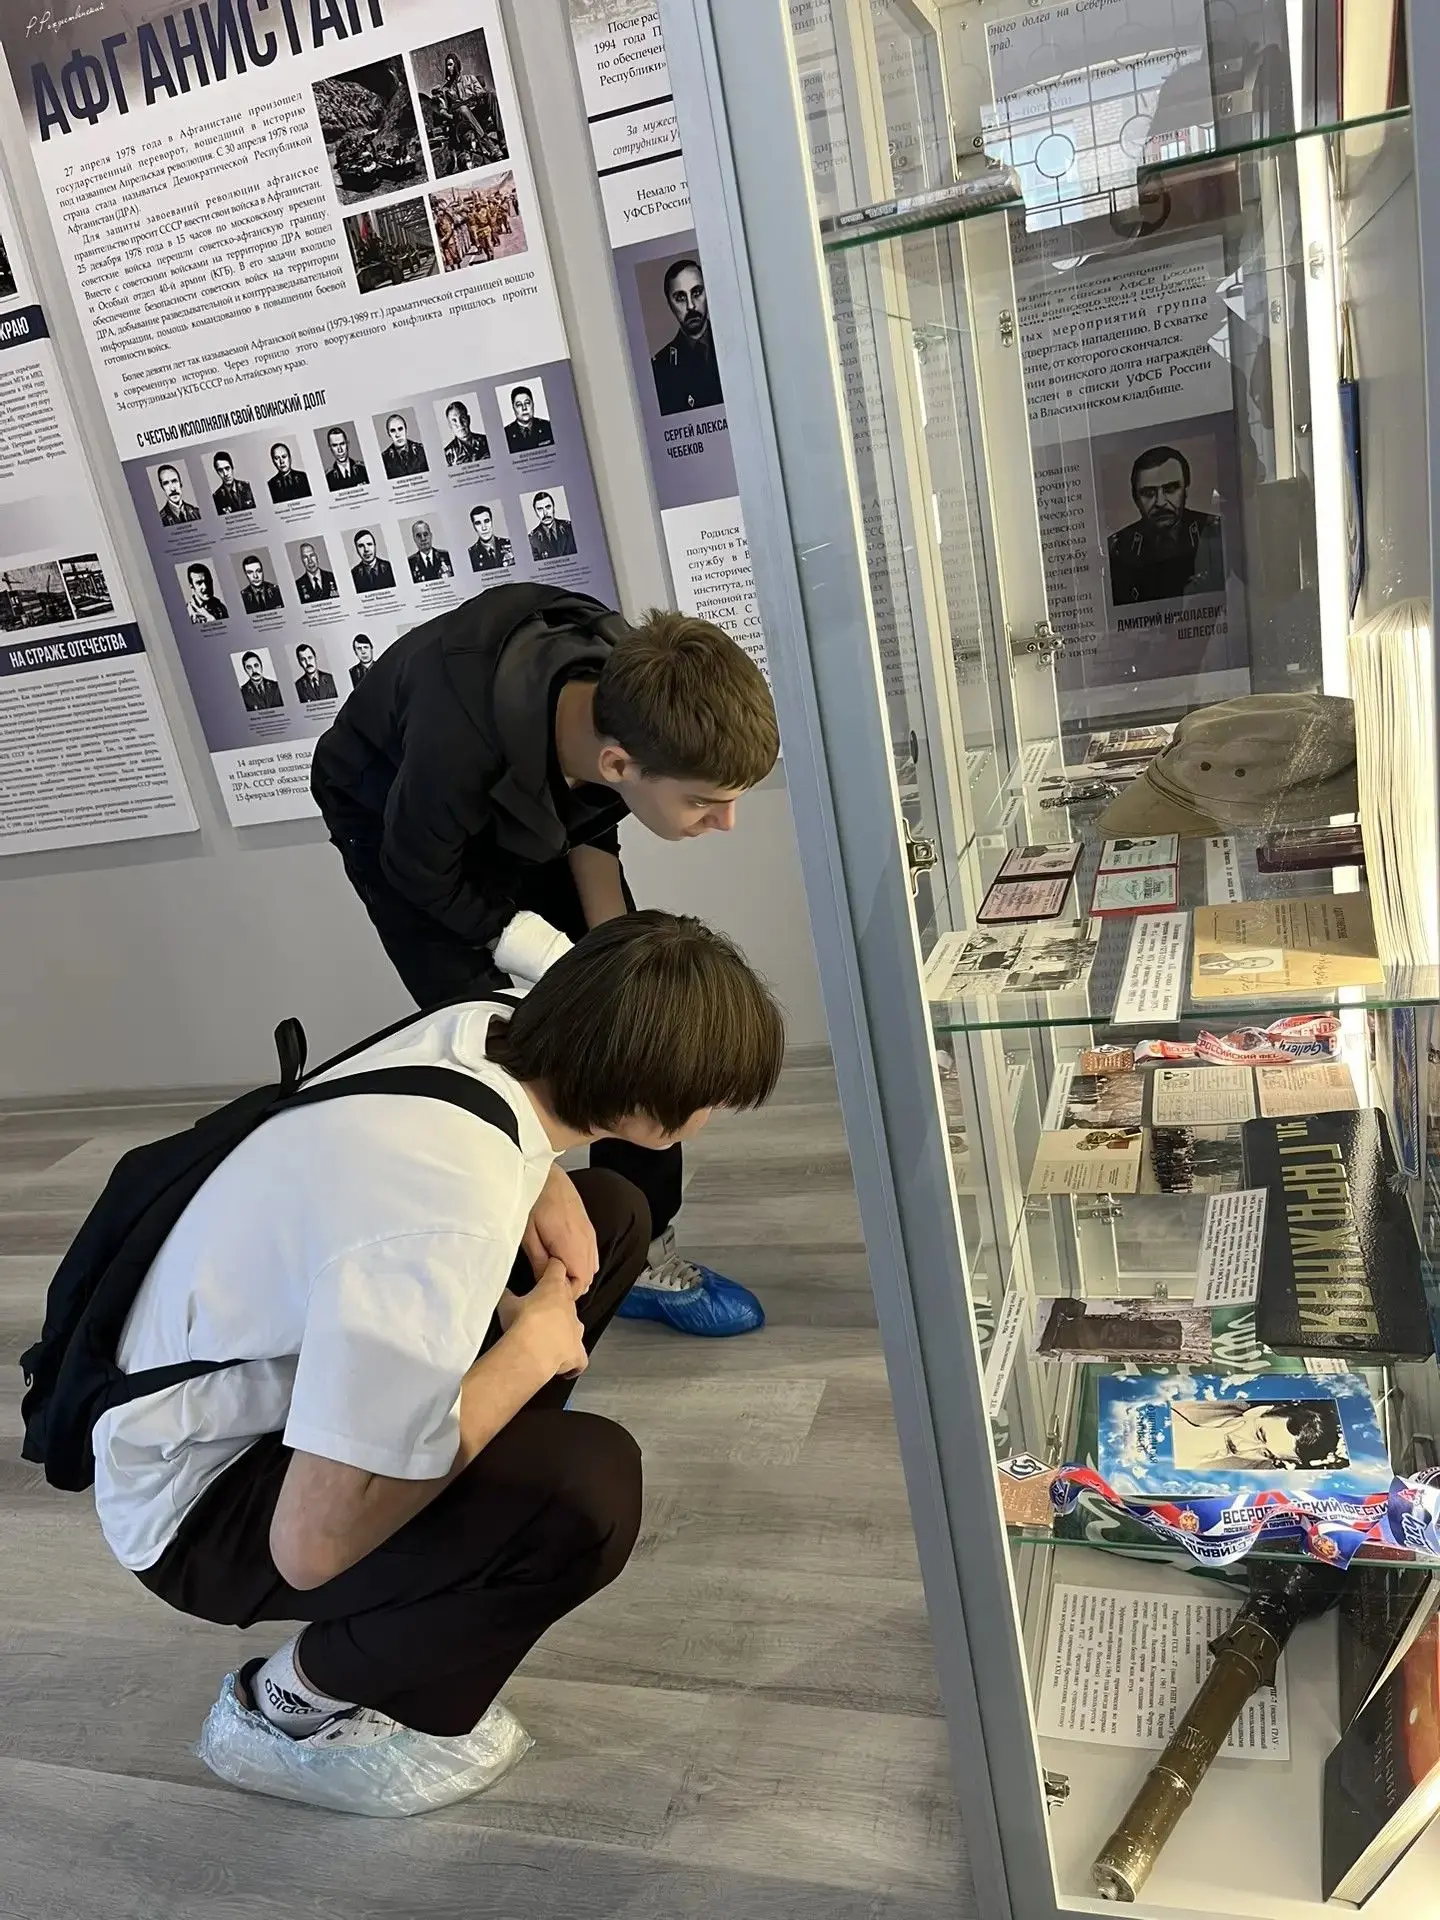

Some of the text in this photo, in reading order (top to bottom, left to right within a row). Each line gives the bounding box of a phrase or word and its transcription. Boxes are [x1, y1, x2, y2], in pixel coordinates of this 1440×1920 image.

[607, 17, 639, 33] После
[1022, 13, 1051, 28] долга
[1056, 8, 1070, 18] на
[593, 38, 616, 54] 1994
[622, 32, 645, 46] года
[597, 60, 610, 70] по
[599, 62, 666, 86] Республики»
[63, 165, 73, 177] 27
[80, 156, 110, 172] апреля
[116, 145, 136, 159] 1978
[141, 139, 162, 151] года
[179, 112, 241, 139] Афганистане
[248, 92, 302, 117] произошел
[626, 124, 637, 136] За
[55, 162, 132, 194] государственный
[137, 146, 188, 167] переворот,
[193, 125, 244, 148] вошедший
[262, 107, 305, 126] историю
[612, 133, 668, 156] сотрудники
[59, 121, 308, 207] под названием Апрельская революция. С 30 апреля 1978 года
[62, 135, 312, 221] страна стала называться Демократической Республикой
[636, 184, 676, 200] Немало
[82, 165, 318, 244] Для защиты завоеваний революции афганское
[623, 202, 654, 222] УФСБ
[67, 203, 141, 234] Афганистан (ДРА).
[84, 223, 332, 300] Вместе с советскими войсками на территорию ДРА вошел
[1052, 308, 1146, 336] мероприятий
[1157, 295, 1206, 315] группа
[0, 316, 30, 342] КРАЮ
[123, 376, 176, 396] современную
[181, 366, 219, 381] историю.
[223, 358, 249, 371] Через
[254, 348, 289, 364] горнило
[295, 341, 318, 353] этого
[323, 324, 386, 345] вооруженного
[392, 310, 442, 328] конфликта
[448, 297, 496, 316] пришлось
[502, 286, 537, 302] пройти
[1080, 325, 1152, 347] нападению.
[1153, 319, 1161, 331] В
[1162, 312, 1208, 328] схватке
[1052, 358, 1065, 368] от
[1066, 347, 1118, 365] которого
[1119, 334, 1182, 354] скончался.
[1048, 366, 1106, 385] воинского
[1109, 359, 1142, 374] долга
[1145, 343, 1210, 365] награждён
[1066, 389, 1072, 397] в
[1078, 379, 1119, 394] списки
[1126, 367, 1162, 387] УФСБ
[1168, 360, 1211, 376] России
[1039, 395, 1120, 418] Власихинском
[1122, 383, 1183, 402] кладбище.
[136, 389, 326, 447] С ЧЕСТЬЮ ИСПОЛНЯЛИ СВОЙ ВОИНСКИЙ ДОЛГ
[664, 418, 727, 440] СЕРГЕЙ АЛЕКСА
[667, 442, 703, 457] ЧЕБЕКОВ
[700, 526, 739, 539] Родился
[686, 542, 726, 556] получил
[688, 555, 724, 569] службу
[690, 565, 751, 582] на историчес
[693, 581, 743, 595] института,
[695, 593, 742, 611] районной
[697, 603, 752, 619] ВЛКСМ. С
[1116, 602, 1227, 632] ДМИТРИЙ НИКОЛАЕВИЧ
[9, 632, 128, 668] НА СТРАЖЕ ОТЕЧЕСТВА
[236, 759, 245, 767] 14
[248, 756, 274, 766] апреля
[294, 751, 312, 759] года
[1278, 1039, 1323, 1057] Gallery
[1276, 1121, 1380, 1335] ул. ГАРАЖНАЯ
